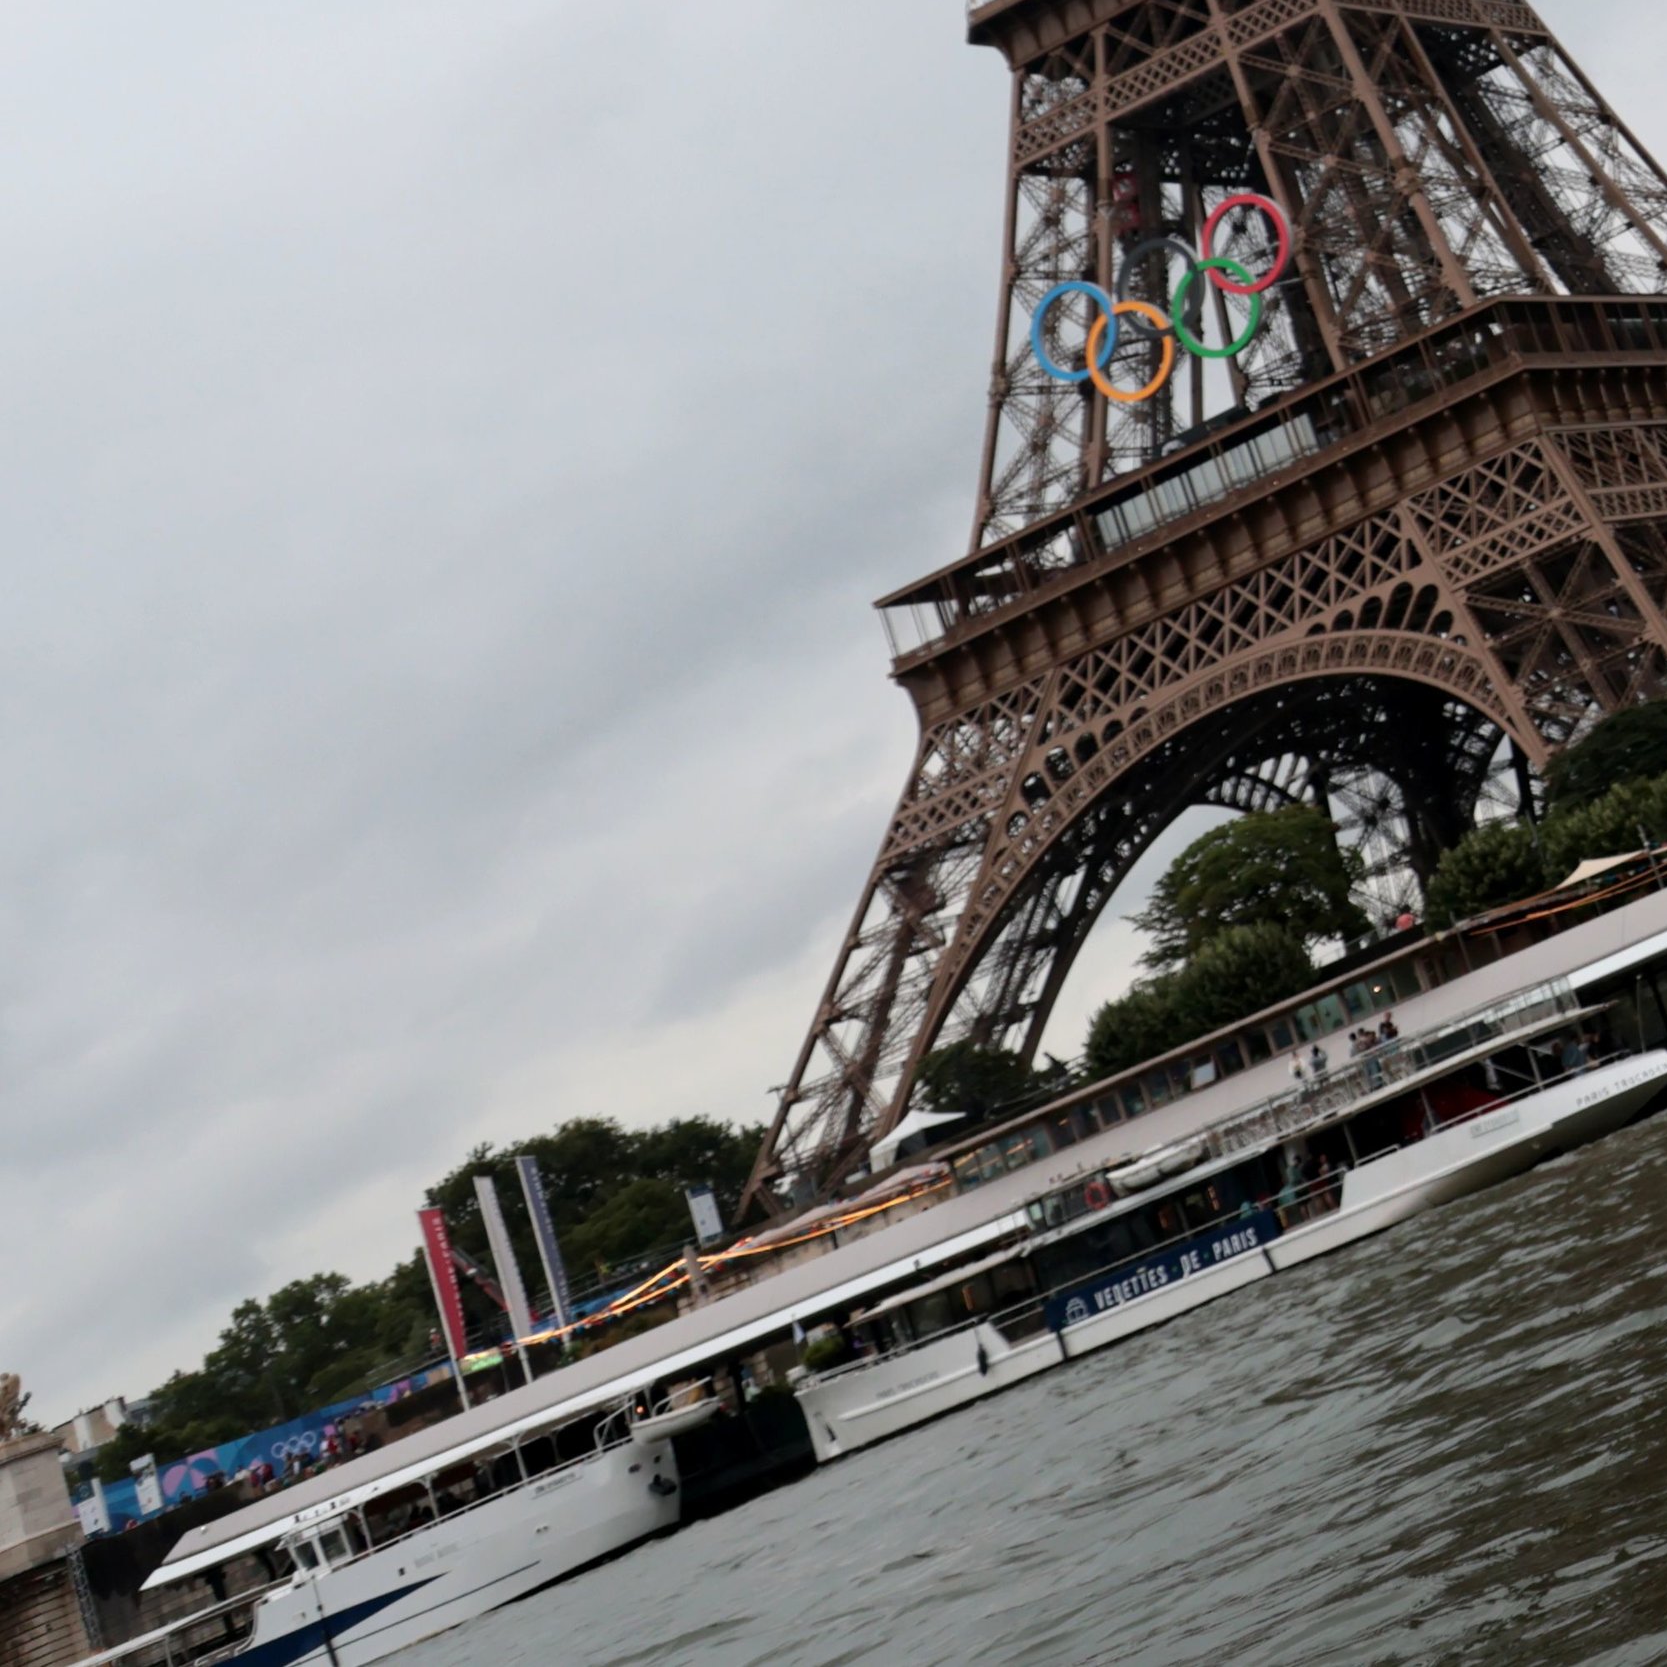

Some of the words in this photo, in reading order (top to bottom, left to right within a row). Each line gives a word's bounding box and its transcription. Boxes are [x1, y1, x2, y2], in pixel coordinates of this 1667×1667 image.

[1575, 1086, 1610, 1108] PARIS
[1093, 1264, 1169, 1310] VEDETTES
[1179, 1250, 1201, 1276] DE
[1212, 1227, 1258, 1261] PARIS
